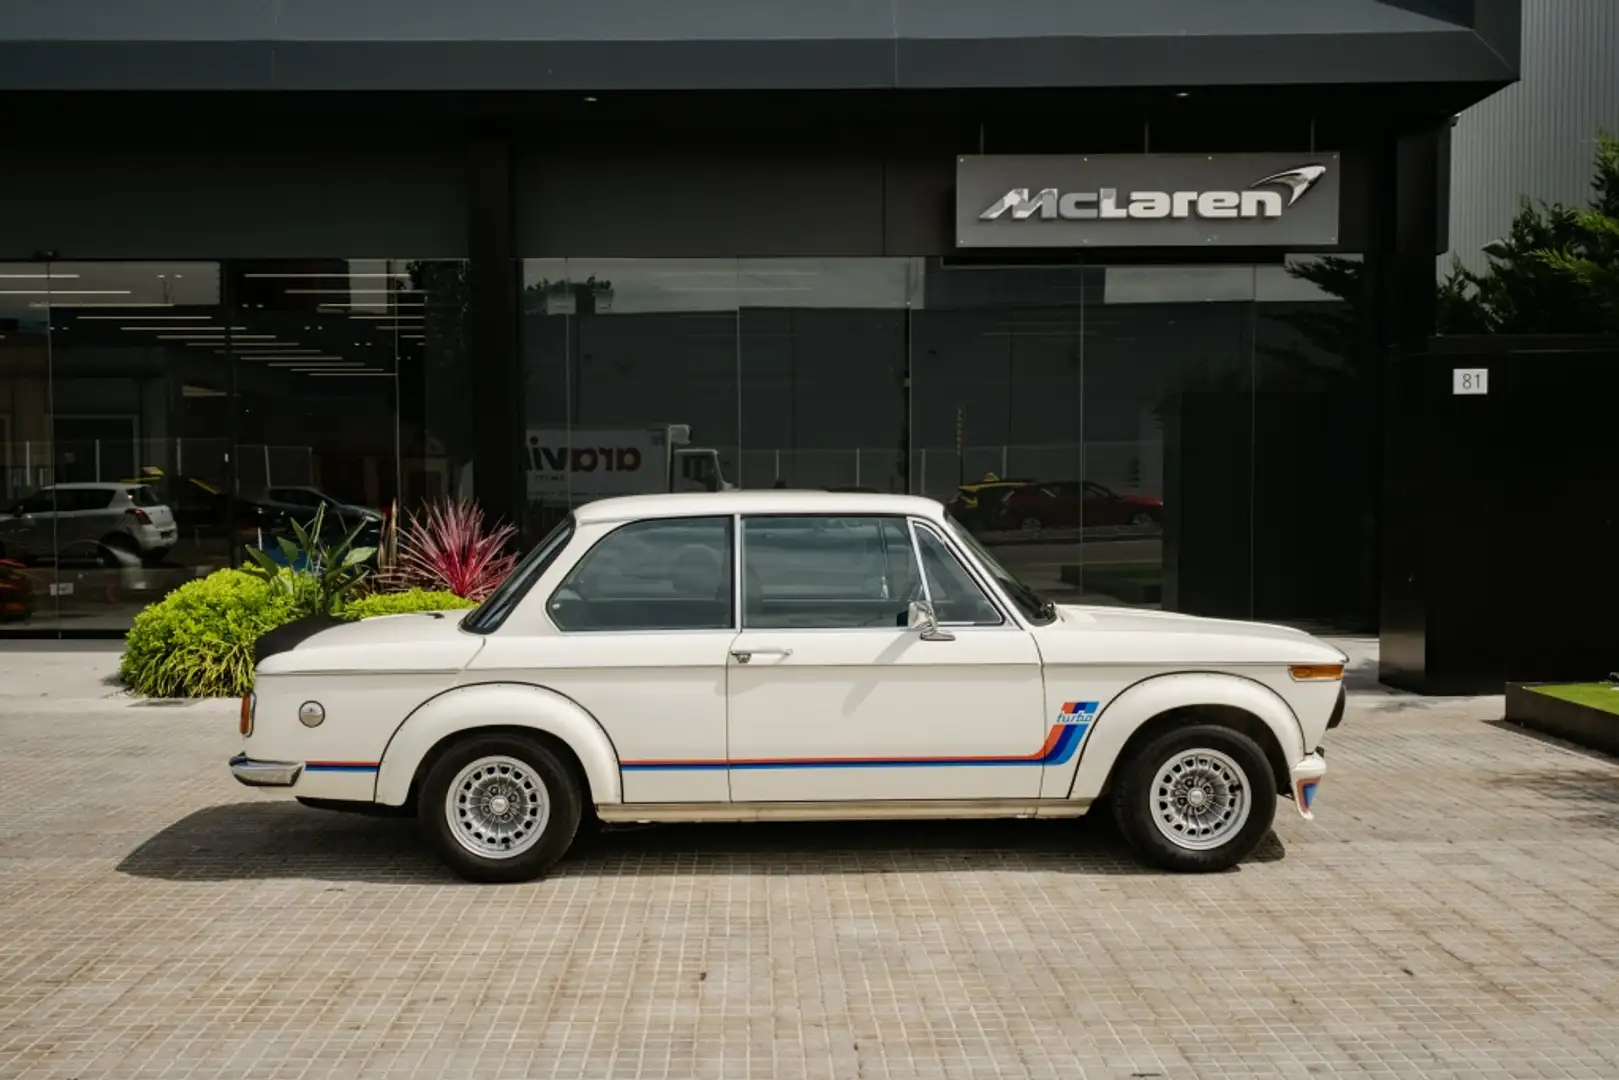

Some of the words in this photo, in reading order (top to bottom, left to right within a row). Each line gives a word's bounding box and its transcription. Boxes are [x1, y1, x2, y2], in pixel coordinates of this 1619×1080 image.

[978, 188, 1282, 220] McLaren
[1462, 373, 1480, 390] 81
[1056, 710, 1094, 723] turbo
